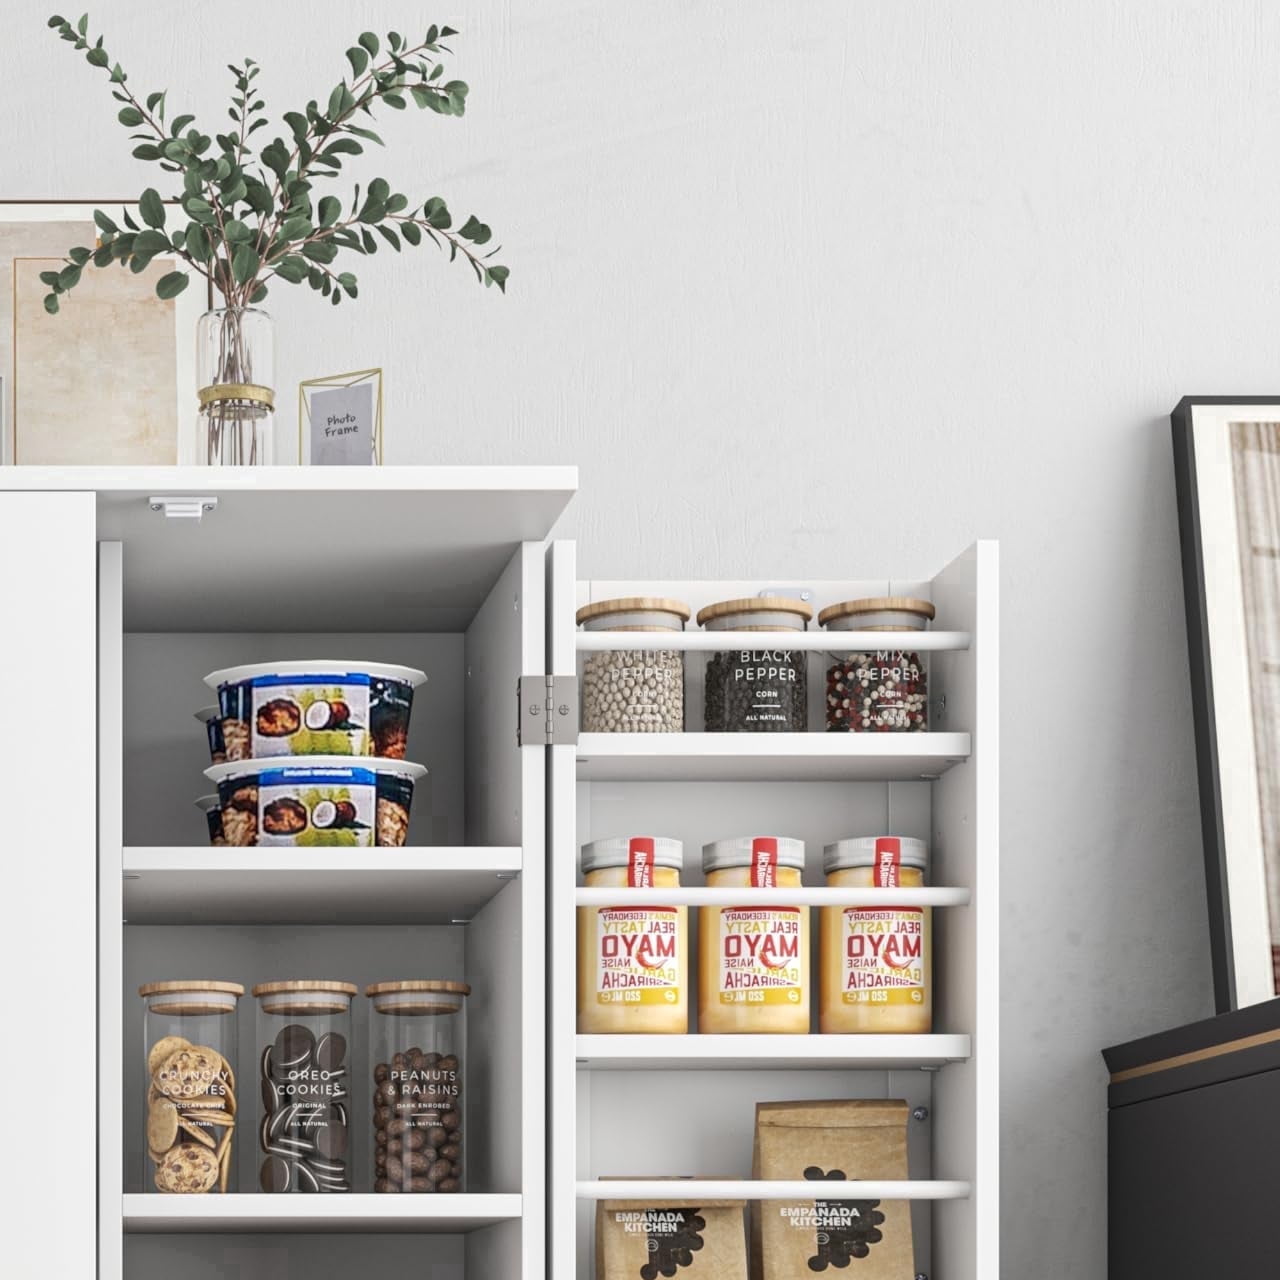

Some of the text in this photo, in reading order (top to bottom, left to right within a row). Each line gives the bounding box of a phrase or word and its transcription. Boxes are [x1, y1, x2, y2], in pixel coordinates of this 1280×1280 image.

[327, 413, 356, 426] Photo
[324, 425, 358, 437] Frame
[741, 650, 792, 663] BLACK
[877, 650, 905, 662] MIX
[612, 668, 672, 681] PEPPER
[735, 667, 796, 681] PEPPER
[859, 667, 920, 681] PEPPER
[756, 690, 778, 698] CORN
[288, 1070, 330, 1080] OREO
[391, 1070, 456, 1081] PEANUTS
[163, 1085, 226, 1095] COOKIES
[277, 1084, 340, 1095] COOKIES
[387, 1084, 458, 1096] & RAISINS
[615, 1212, 685, 1222] EMPANADA
[780, 1207, 860, 1216] EMPANADA
[624, 1222, 678, 1232] KITCHEN
[790, 1217, 852, 1226] KITCHEN
